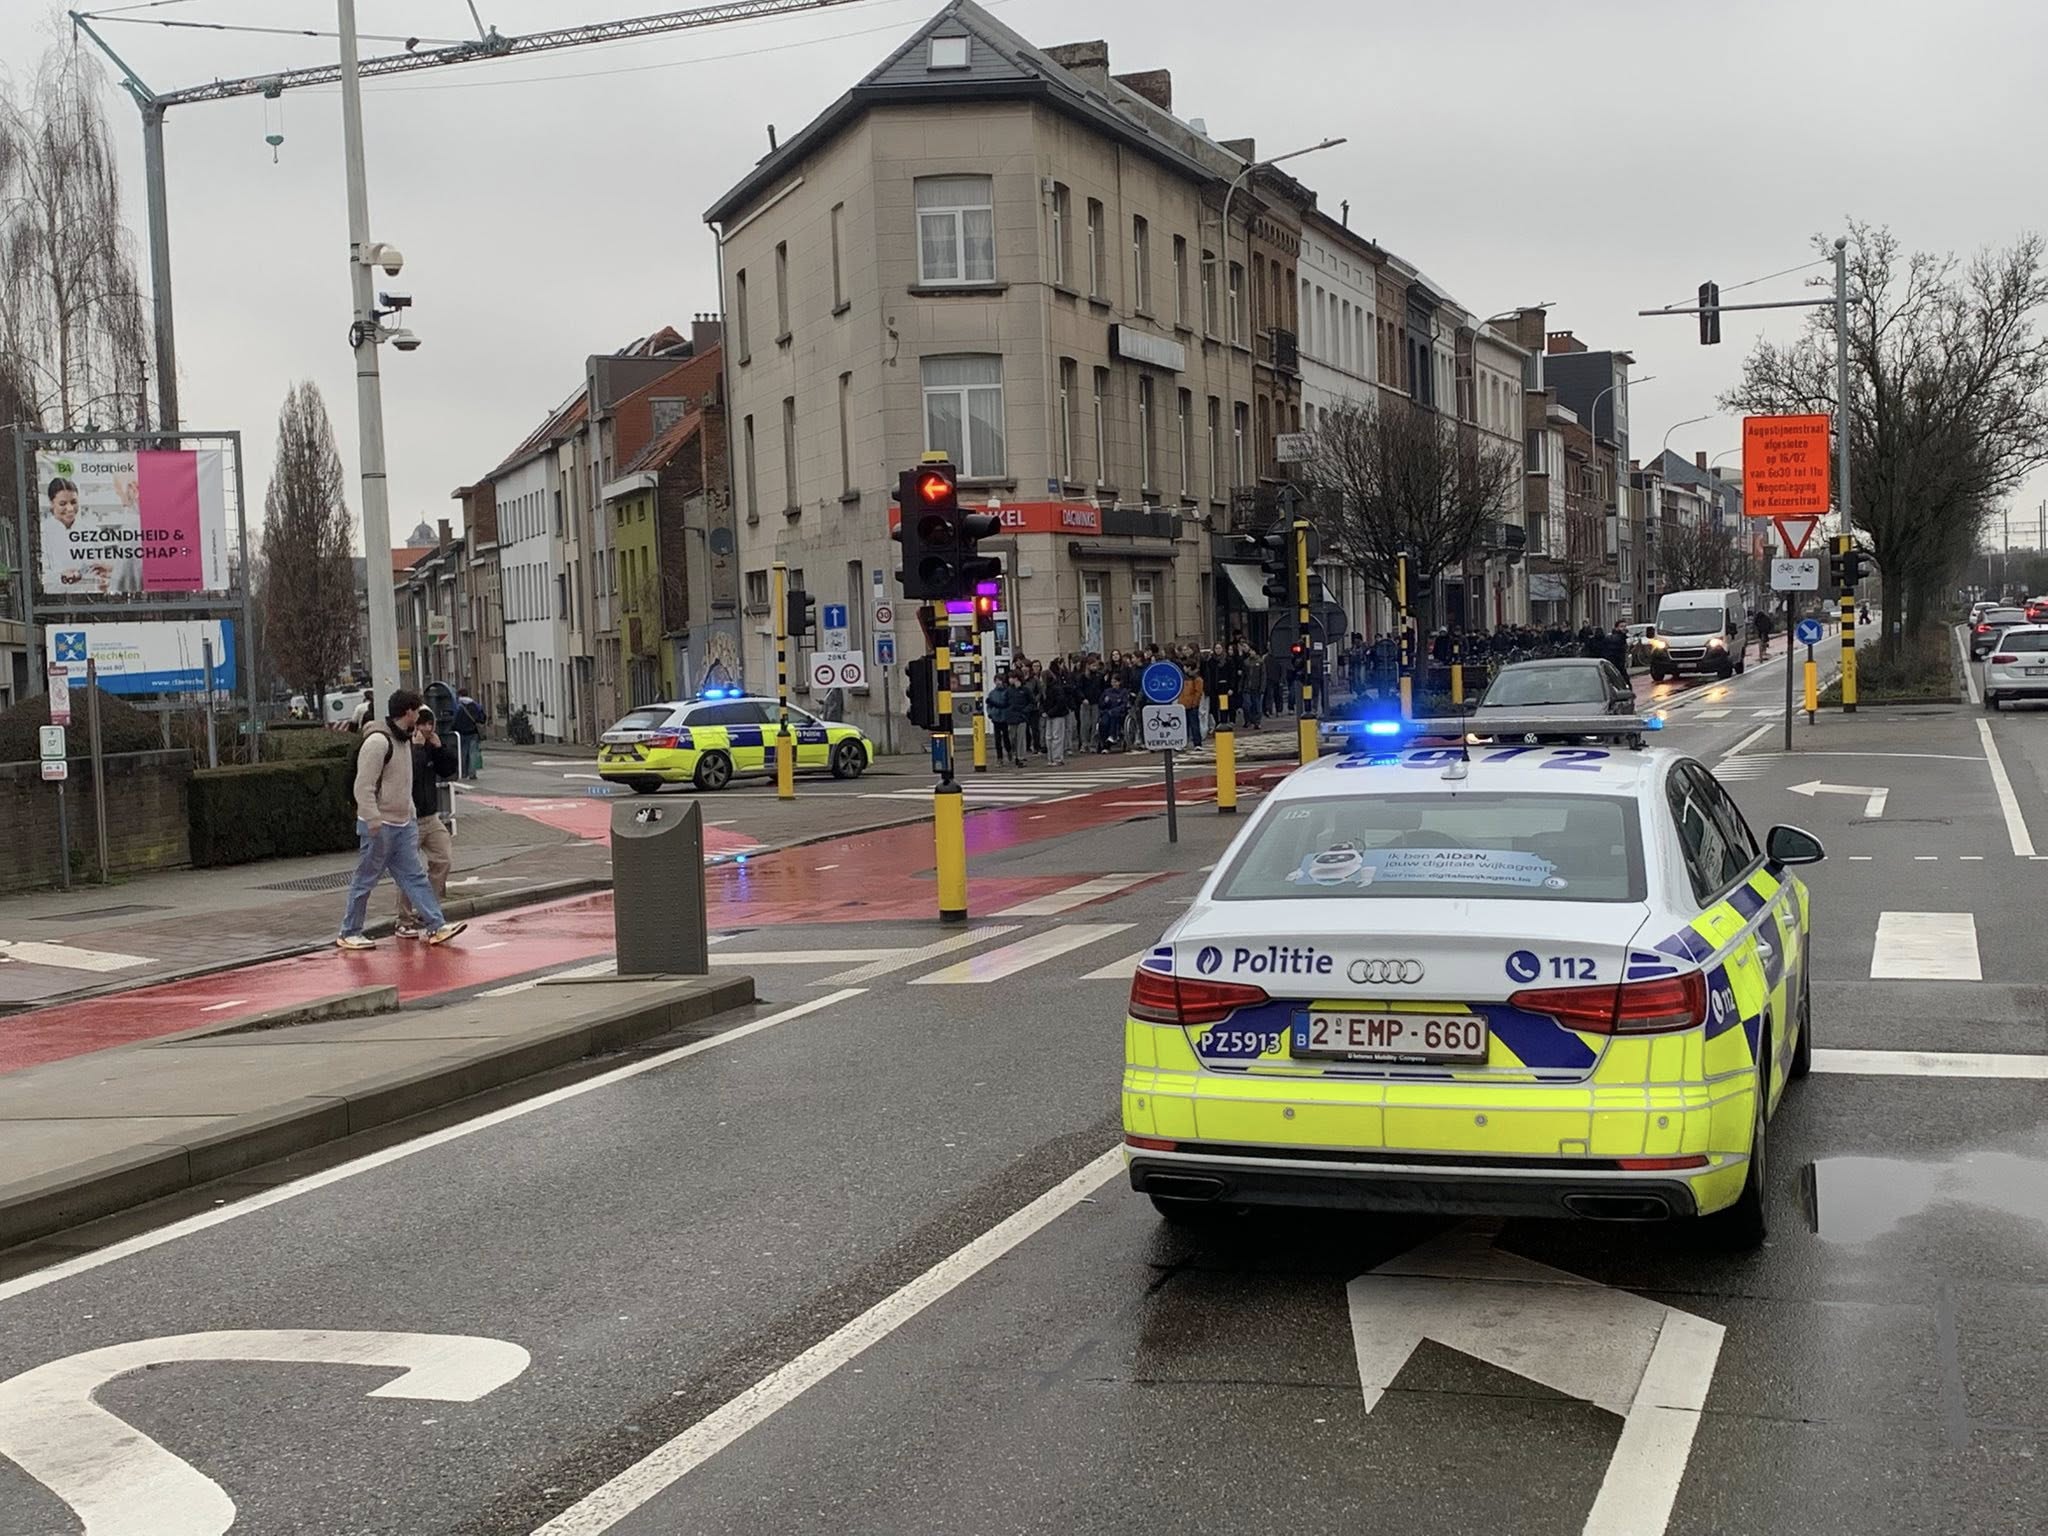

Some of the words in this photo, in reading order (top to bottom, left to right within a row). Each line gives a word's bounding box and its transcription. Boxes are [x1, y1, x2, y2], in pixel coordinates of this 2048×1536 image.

[1748, 424, 1824, 437] Augustijnenstraat
[1764, 440, 1808, 451] afgesloten
[1766, 456, 1776, 465] op
[81, 463, 135, 474] Botaniek
[1750, 470, 1765, 478] van
[1794, 467, 1806, 477] tot
[1756, 482, 1817, 494] Wegomlegging
[1752, 498, 1766, 508] via
[1768, 496, 1820, 507] Keizerstraat
[1063, 509, 1097, 527] DAGWINKEL
[69, 530, 169, 543] GEZONDHEID
[173, 529, 184, 541] &
[70, 547, 178, 560] WETENSCHAP
[879, 611, 889, 619] 30
[1403, 852, 1430, 860] ben
[1385, 860, 1419, 868] jouw
[1423, 860, 1475, 868] digitale
[1232, 945, 1333, 974] Politie
[1549, 956, 1598, 980] 112
[1721, 987, 1736, 1013] 112
[1201, 1031, 1281, 1054] PZ5913
[1296, 1034, 1307, 1047] B
[1399, 1054, 1426, 1062] Company
